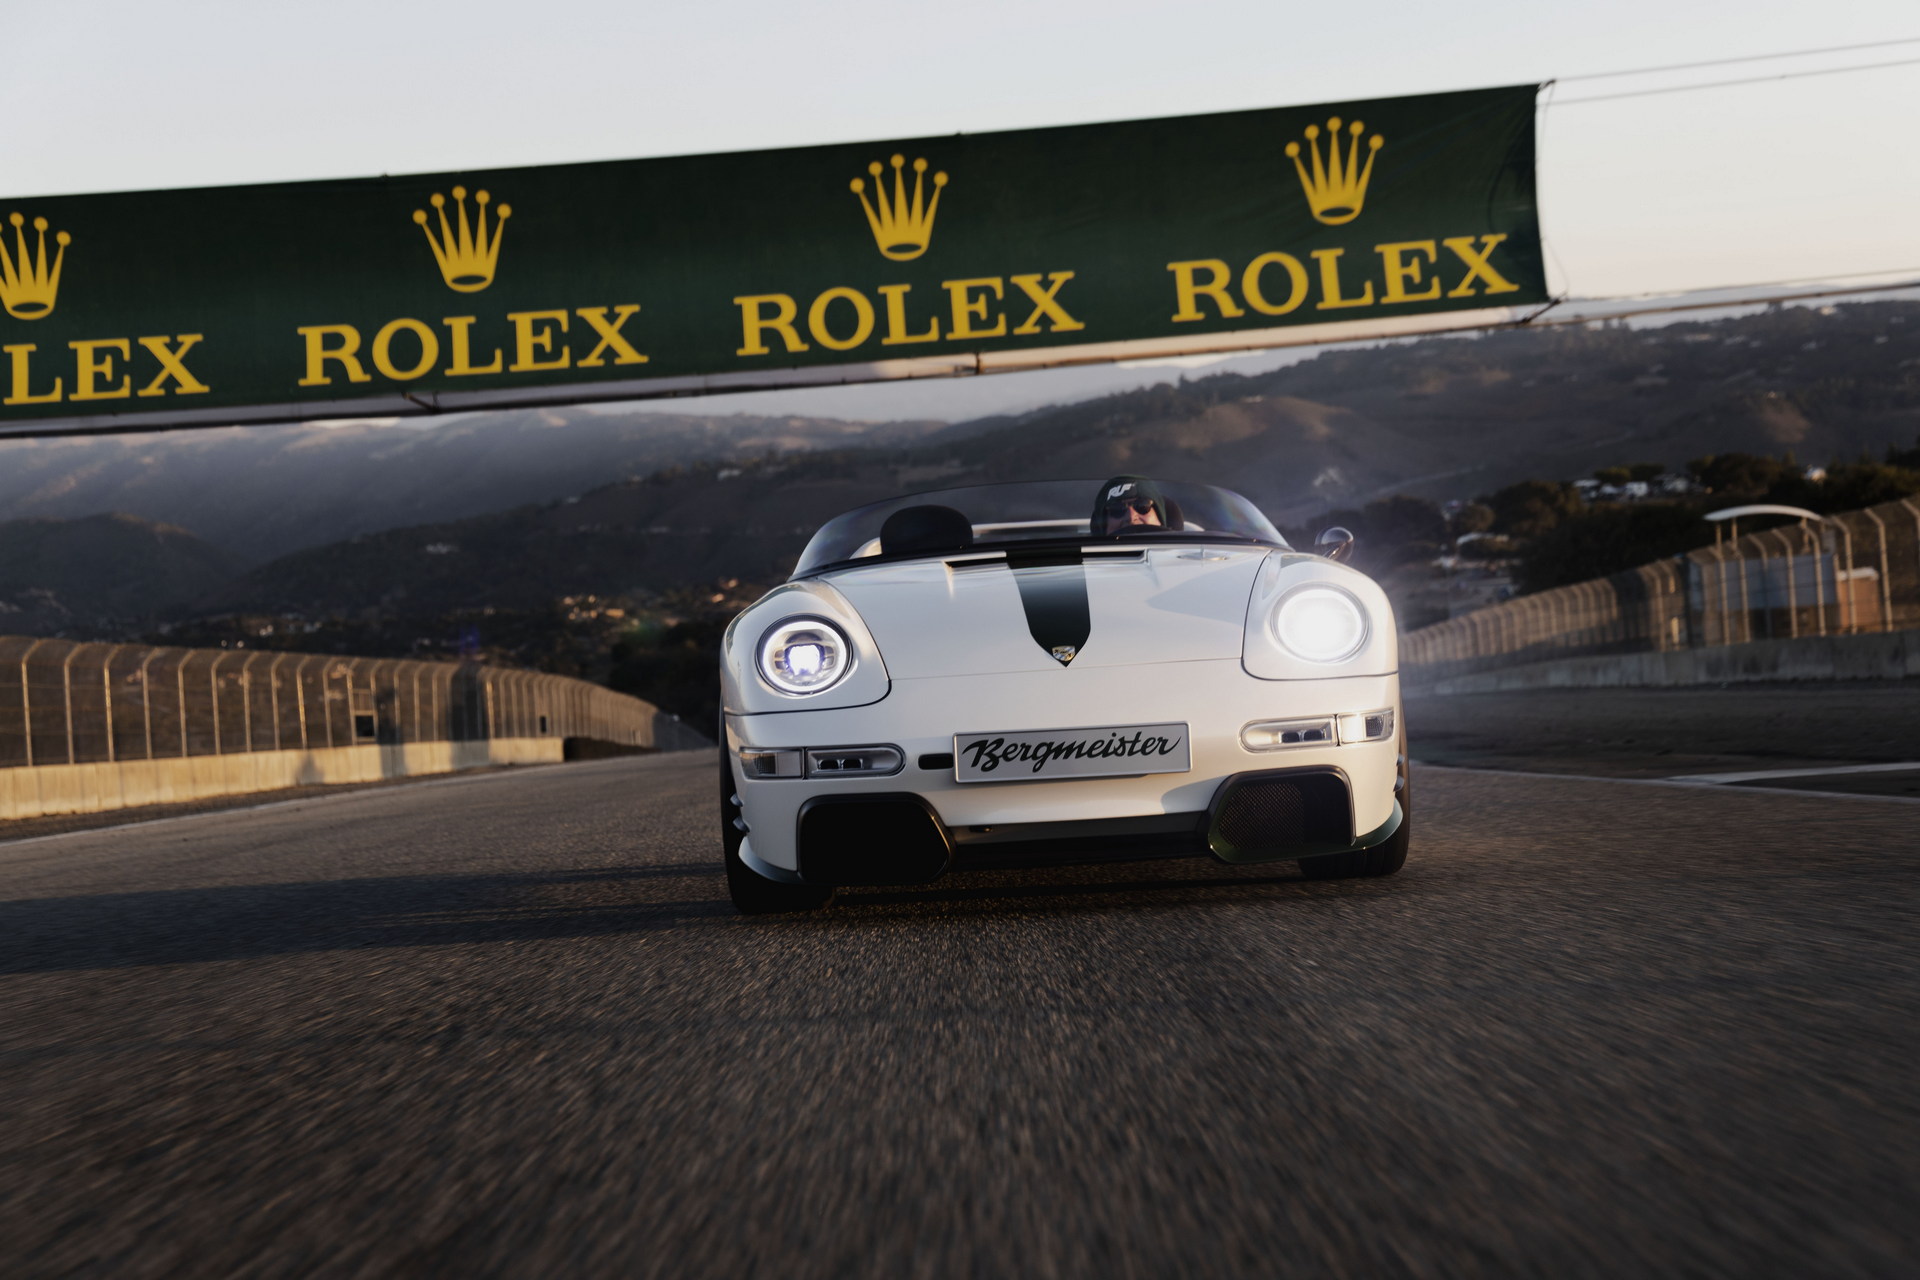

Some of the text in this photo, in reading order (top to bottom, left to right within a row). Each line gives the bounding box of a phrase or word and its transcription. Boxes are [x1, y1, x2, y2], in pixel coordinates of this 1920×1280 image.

[733, 271, 1085, 356] ROLEX
[1167, 234, 1520, 323] ROLEX
[297, 304, 649, 387] ROLEX
[961, 731, 1182, 773] Bergmeister
